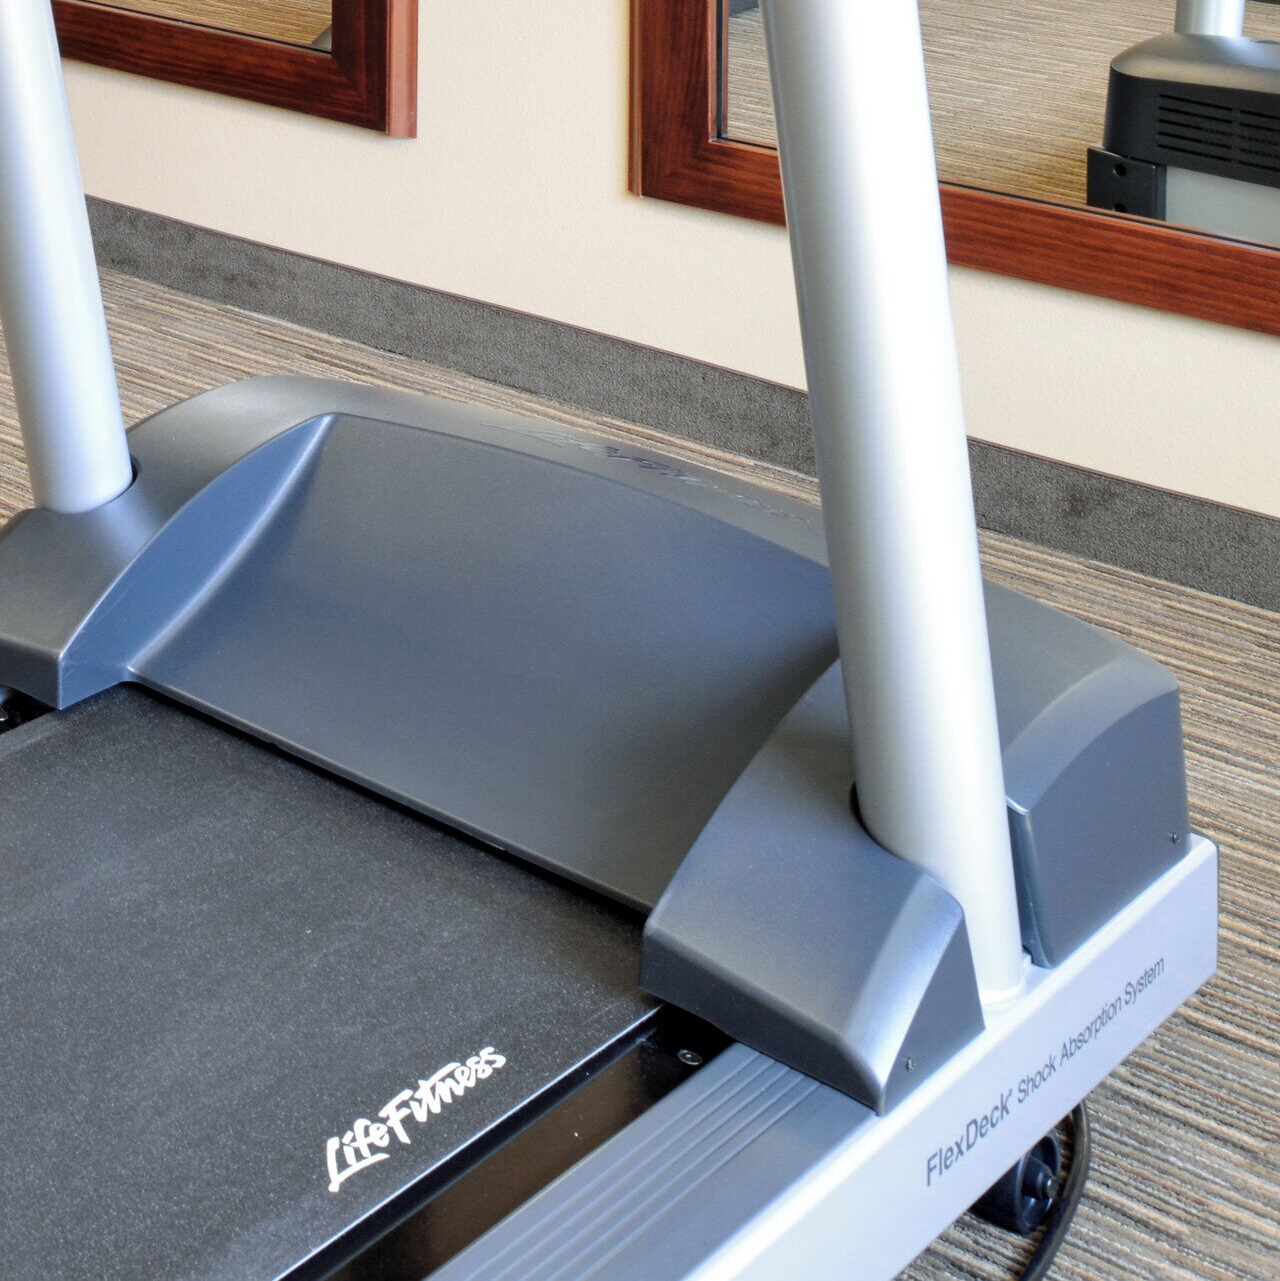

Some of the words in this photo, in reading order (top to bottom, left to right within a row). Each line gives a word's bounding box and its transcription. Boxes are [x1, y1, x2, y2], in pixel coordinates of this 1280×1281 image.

[925, 1092, 1011, 1187] FlexDeck
[1017, 1053, 1057, 1104] Shock
[1060, 996, 1122, 1063] Absorption
[1124, 957, 1165, 1005] System
